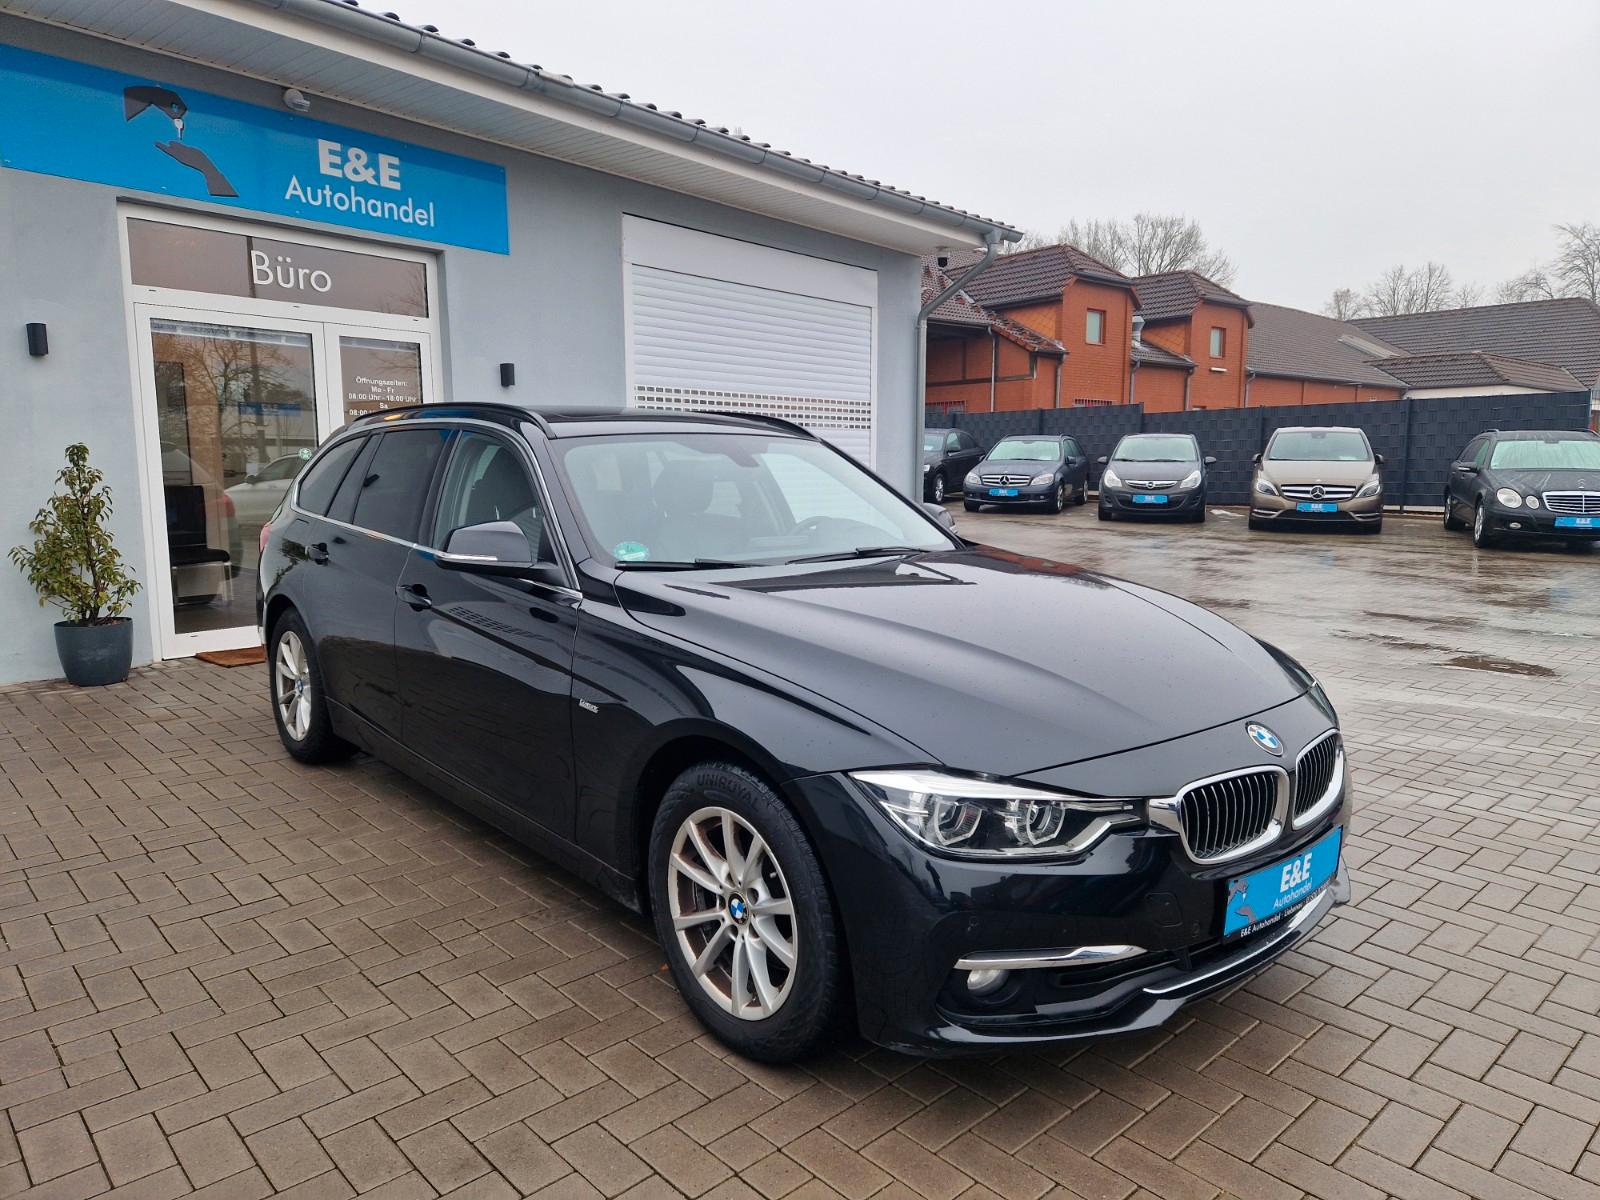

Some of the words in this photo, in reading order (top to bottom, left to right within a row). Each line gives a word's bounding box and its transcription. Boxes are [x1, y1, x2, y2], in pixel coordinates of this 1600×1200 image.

[318, 138, 401, 191] E&E
[284, 174, 435, 228] Autohandel
[250, 249, 332, 293] Büro
[348, 392, 367, 400] 08:00
[368, 393, 381, 401] Uhr
[355, 375, 408, 387] Öffnungszeiten:
[697, 773, 759, 813] UNIROYAL
[1280, 852, 1313, 893] E&E
[1273, 876, 1313, 911] Autohandel
[1240, 925, 1252, 938] E&E
